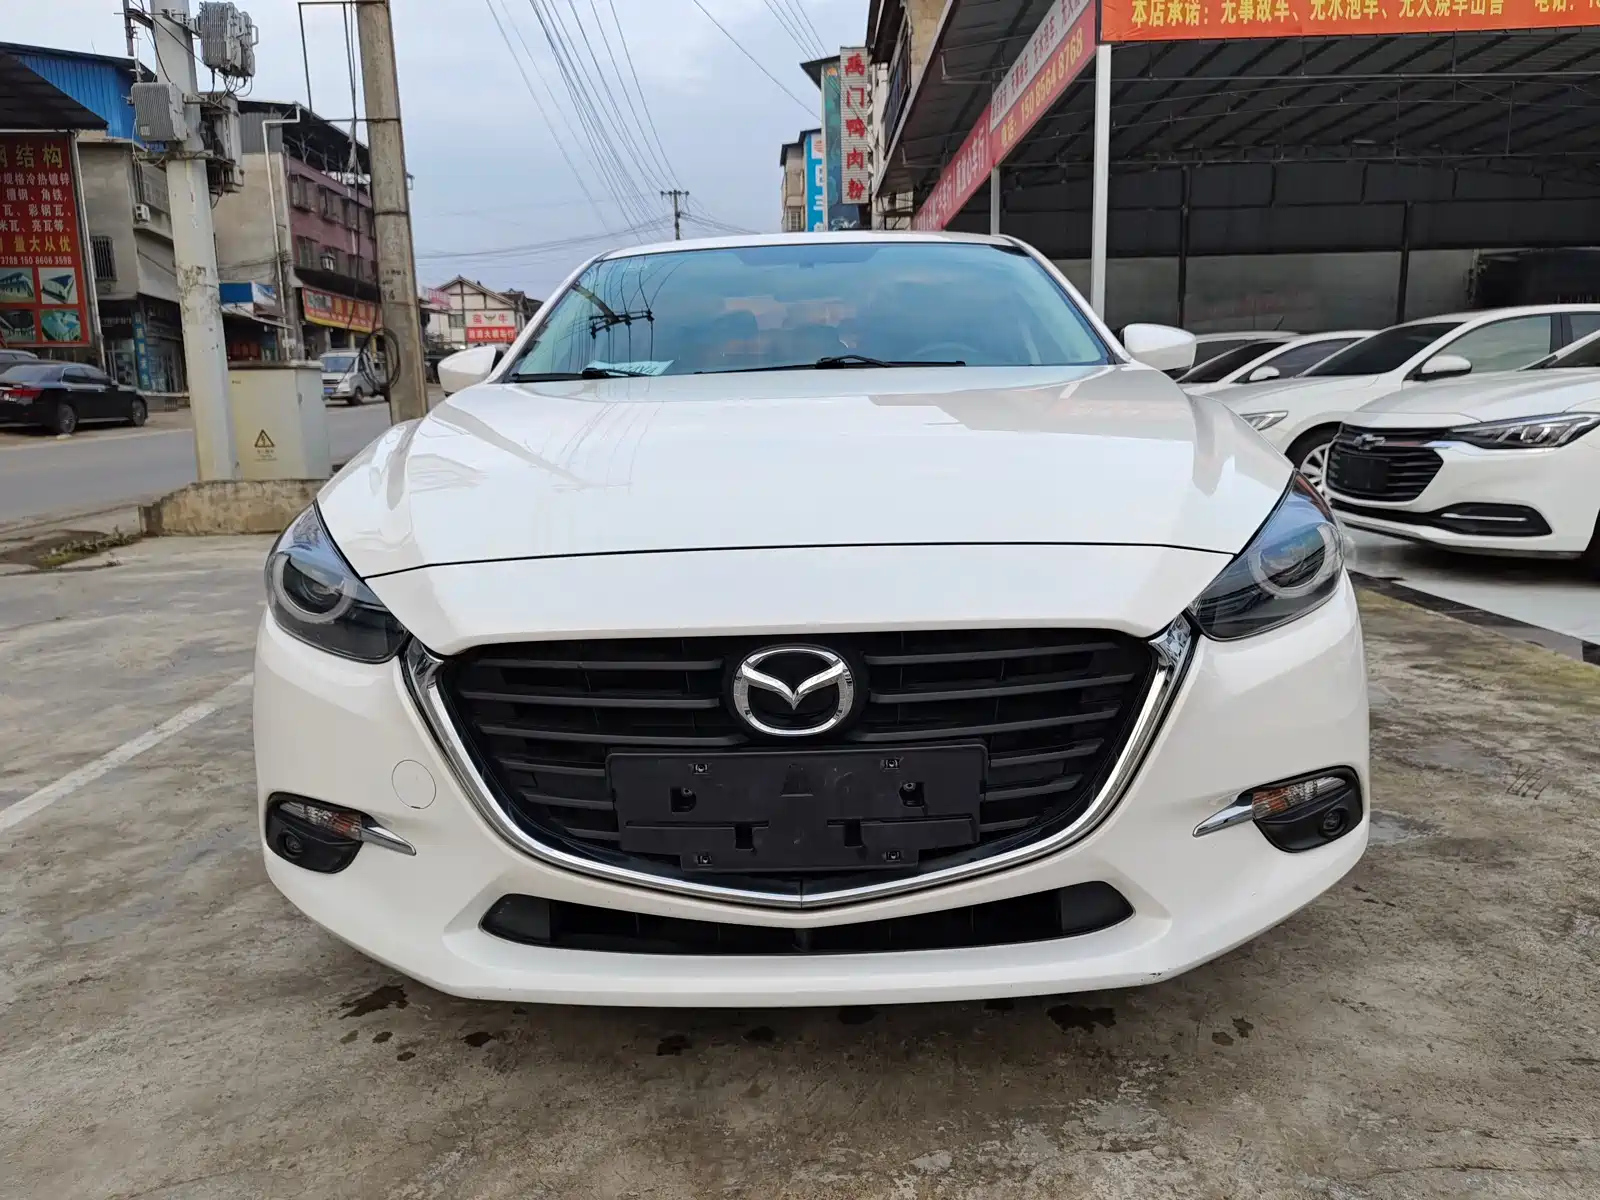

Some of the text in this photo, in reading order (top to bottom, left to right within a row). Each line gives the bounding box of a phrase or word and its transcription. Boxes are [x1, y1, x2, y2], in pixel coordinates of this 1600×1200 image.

[1058, 28, 1083, 81] 8768
[0, 171, 70, 187] 规格冷热镀锌
[13, 233, 71, 253] 量大从优
